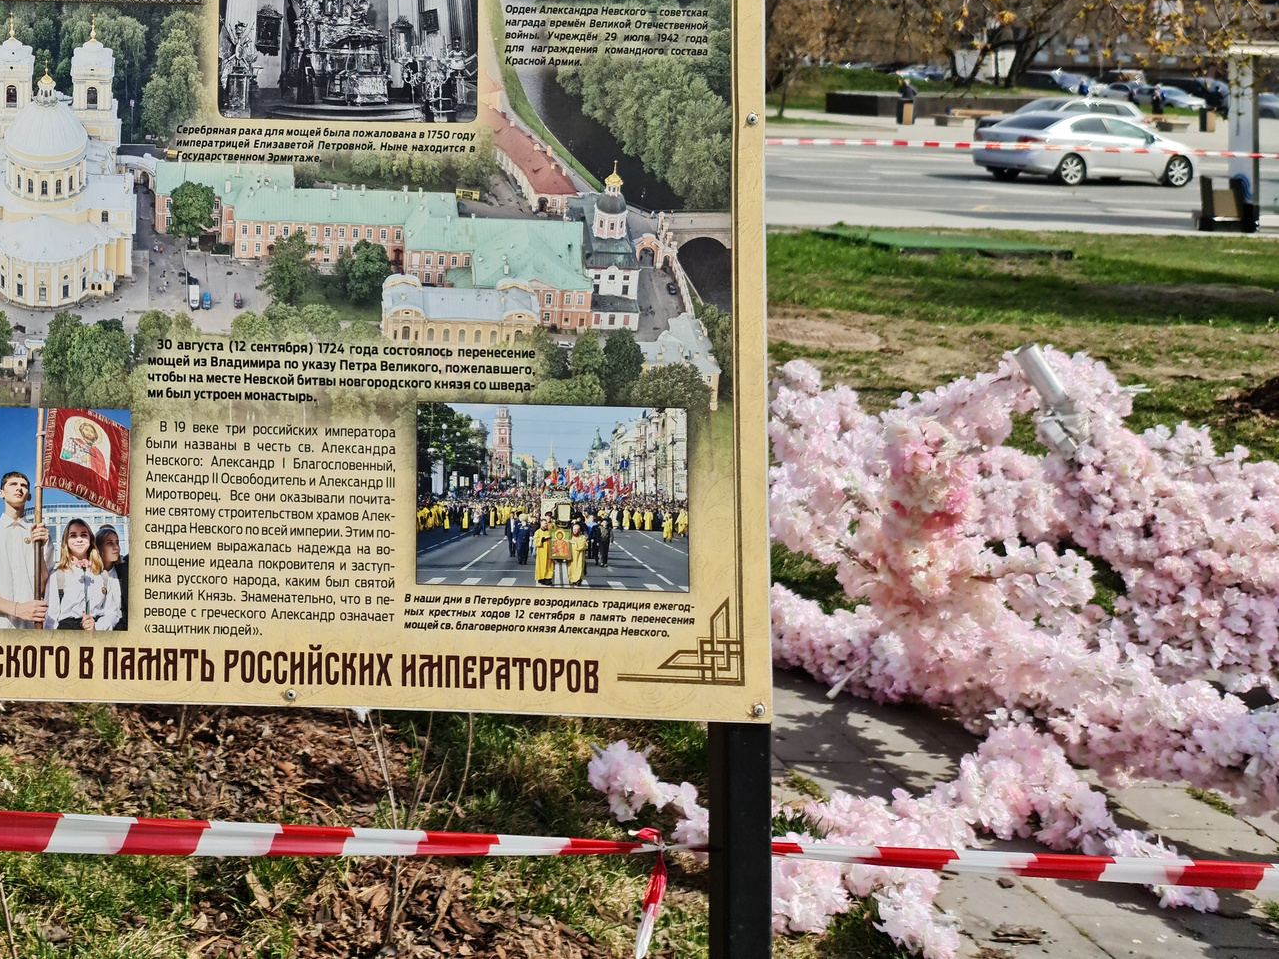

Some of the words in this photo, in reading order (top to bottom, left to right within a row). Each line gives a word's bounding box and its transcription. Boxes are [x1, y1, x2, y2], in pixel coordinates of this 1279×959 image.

[505, 19, 546, 29] награда
[549, 18, 586, 28] времён
[589, 18, 631, 30] Великой
[634, 20, 708, 31] Отечественной
[546, 30, 598, 43] Учреждён
[604, 32, 617, 42] 29
[623, 33, 650, 42] июля
[657, 33, 679, 43] 1942
[685, 34, 708, 44] года
[504, 44, 524, 54] для
[530, 44, 598, 55] награждения
[604, 46, 665, 56] командного
[670, 48, 708, 56] состава
[505, 55, 546, 67] Красной
[176, 124, 237, 139] Серебряная
[238, 127, 263, 138] рака
[264, 128, 285, 139] для
[285, 126, 321, 138] мощей
[322, 127, 350, 137] была
[351, 129, 417, 139] пожалована
[418, 131, 425, 139] в
[427, 129, 450, 139] 1750
[451, 132, 476, 141] году
[175, 138, 250, 149] императрицей
[253, 139, 314, 149] Елизаветой
[316, 140, 376, 152] Петровной.
[379, 141, 408, 151] Ныне
[410, 144, 466, 154] находится
[468, 145, 475, 153] в
[176, 150, 266, 163] Государственном
[266, 152, 322, 164] Эрмитаже.
[156, 338, 173, 351] 30
[176, 341, 224, 355] августа
[228, 339, 247, 355] (12
[249, 341, 314, 356] сентября)
[318, 342, 345, 356] 1724
[349, 344, 379, 358] года
[382, 346, 453, 357] состоялось
[457, 348, 536, 360] перенесение
[147, 354, 190, 368] мощей
[193, 357, 207, 367] из
[210, 355, 281, 370] Владимира
[283, 360, 299, 369] по
[301, 360, 336, 372] указу
[339, 359, 377, 373] Петра
[380, 360, 442, 374] Великого,
[444, 364, 537, 377] пожелавшего,
[159, 420, 167, 432] В
[173, 420, 186, 432] 19
[192, 423, 219, 434] веке
[224, 424, 246, 436] три
[252, 423, 318, 437] российских
[324, 427, 396, 440] императора
[145, 436, 177, 449] были
[184, 440, 237, 451] названы
[243, 441, 251, 451] в
[256, 442, 291, 452] честь
[297, 443, 314, 453] св.
[320, 441, 396, 456] Александра
[145, 453, 203, 467] Невского:
[210, 454, 275, 470] Александр
[282, 457, 285, 469] I
[293, 457, 396, 473] Благословенный,
[403, 608, 425, 616] ных
[428, 608, 476, 618] крестных
[480, 610, 510, 620] ходов
[515, 609, 525, 619] 12
[528, 610, 575, 622] сентября
[578, 613, 585, 621] в
[589, 613, 627, 622] память
[630, 615, 695, 625] перенесения
[78, 645, 94, 679] В
[102, 646, 215, 682] ПАМЯТЬ
[223, 644, 392, 686] РОССИЙСКИХ
[401, 653, 599, 694] ИМПЕРАТОРОВ
